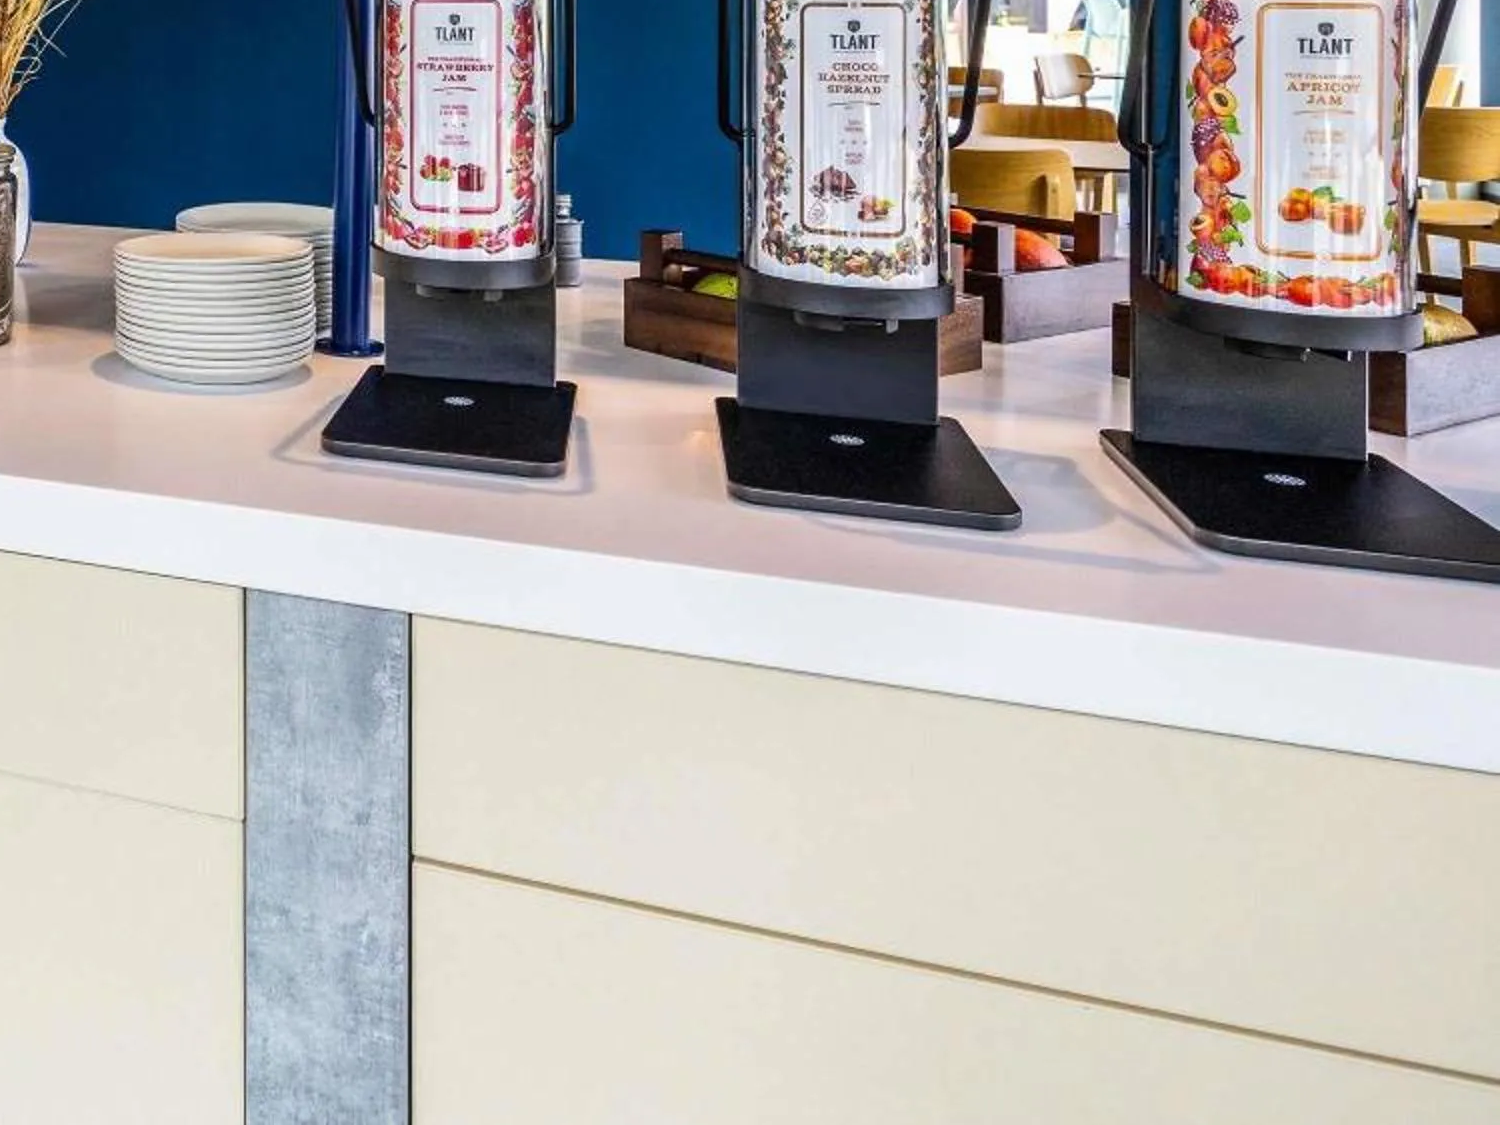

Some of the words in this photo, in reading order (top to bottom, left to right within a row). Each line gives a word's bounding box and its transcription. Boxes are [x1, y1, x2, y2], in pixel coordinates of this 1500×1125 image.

[435, 27, 475, 42] TLANT
[830, 34, 880, 50] TLANT
[1296, 38, 1355, 55] TLANT
[417, 62, 494, 72] STRAWBERRY
[832, 62, 879, 72] CHOCO
[442, 74, 467, 82] JAM
[818, 73, 890, 83] HAZELNUT
[827, 85, 882, 94] SPREAD
[1286, 81, 1361, 93] APRICOT
[1306, 94, 1344, 106] JAM
